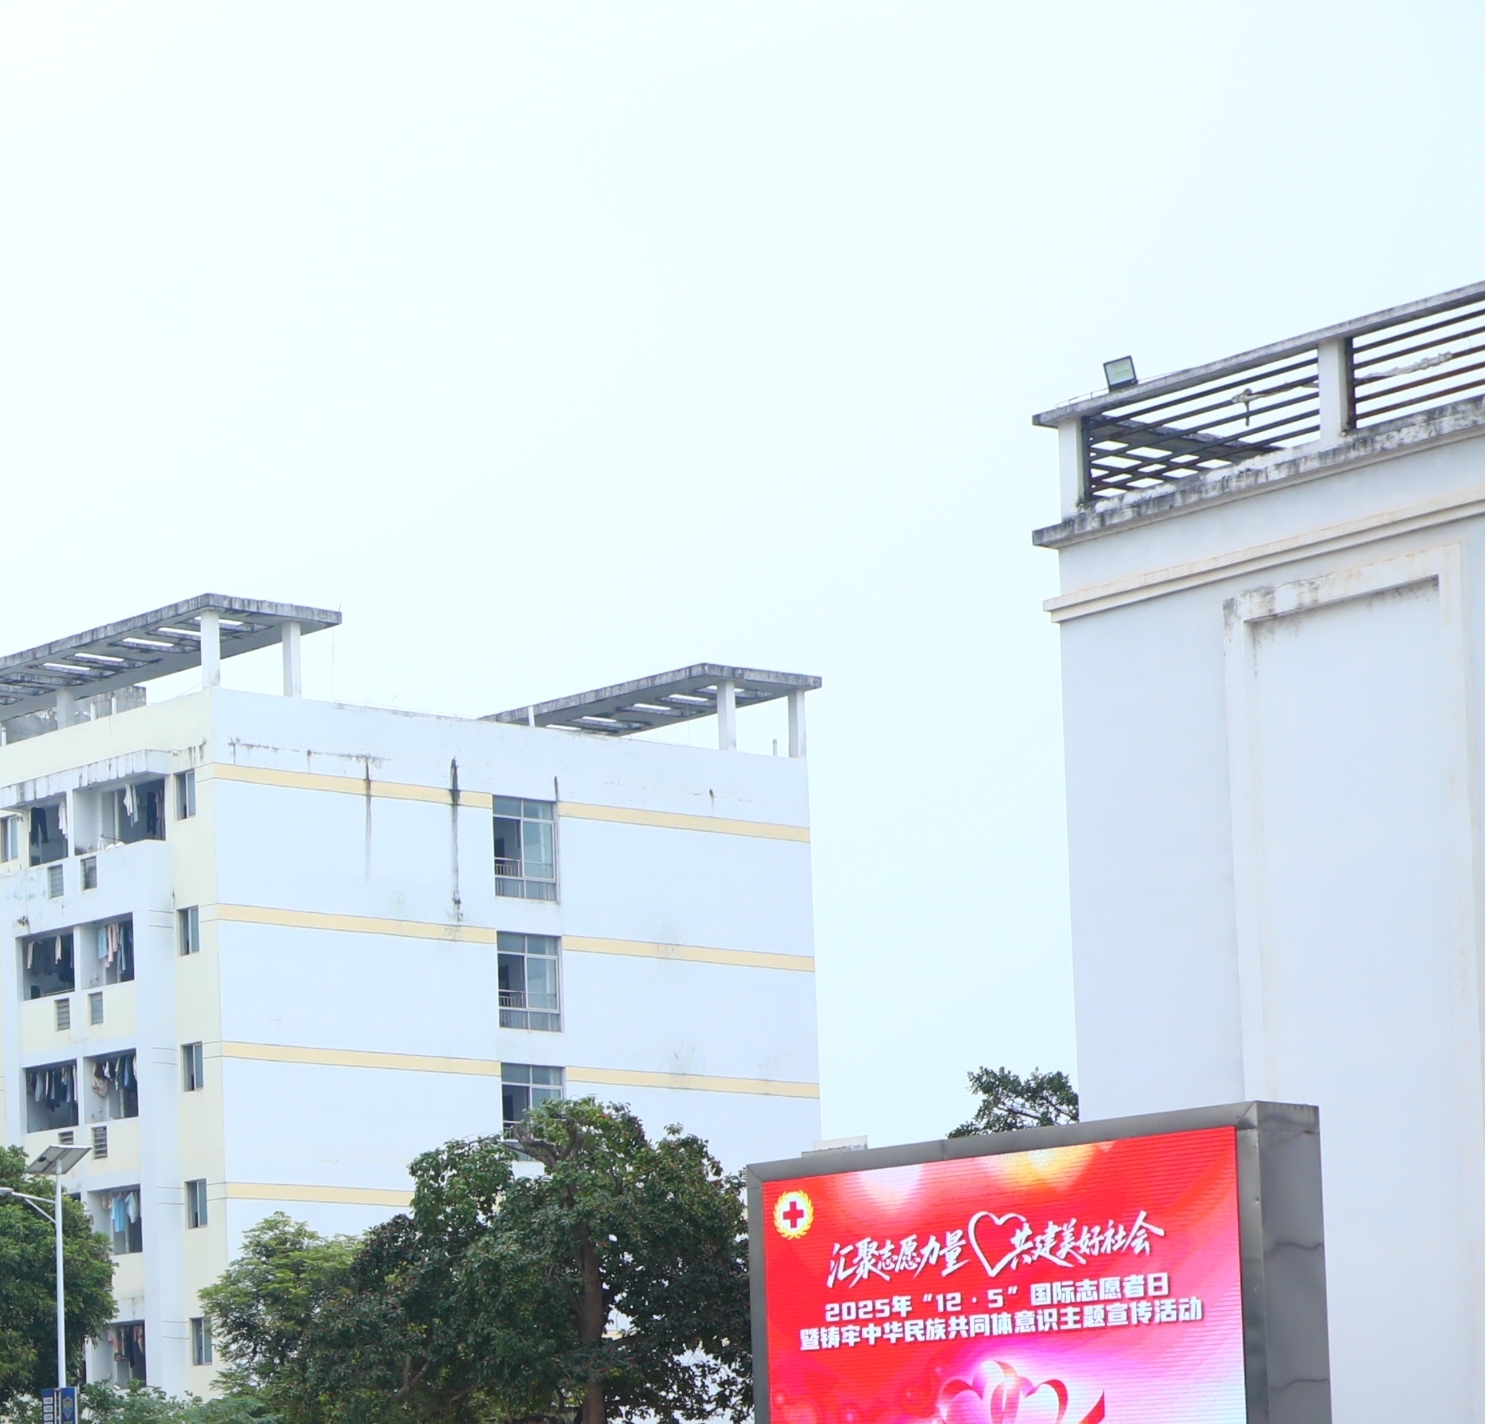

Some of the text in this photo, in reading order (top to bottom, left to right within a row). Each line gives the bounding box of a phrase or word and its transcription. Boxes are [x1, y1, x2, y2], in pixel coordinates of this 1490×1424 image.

[826, 1209, 1165, 1290] 汇聚志愿力量 共建美好社会
[800, 1297, 1202, 1351] 暨铸牢中华民族共同体意识主题宣传活动
[825, 1295, 913, 1322] 2025年
[1030, 1272, 1170, 1306] 国际志愿者日
